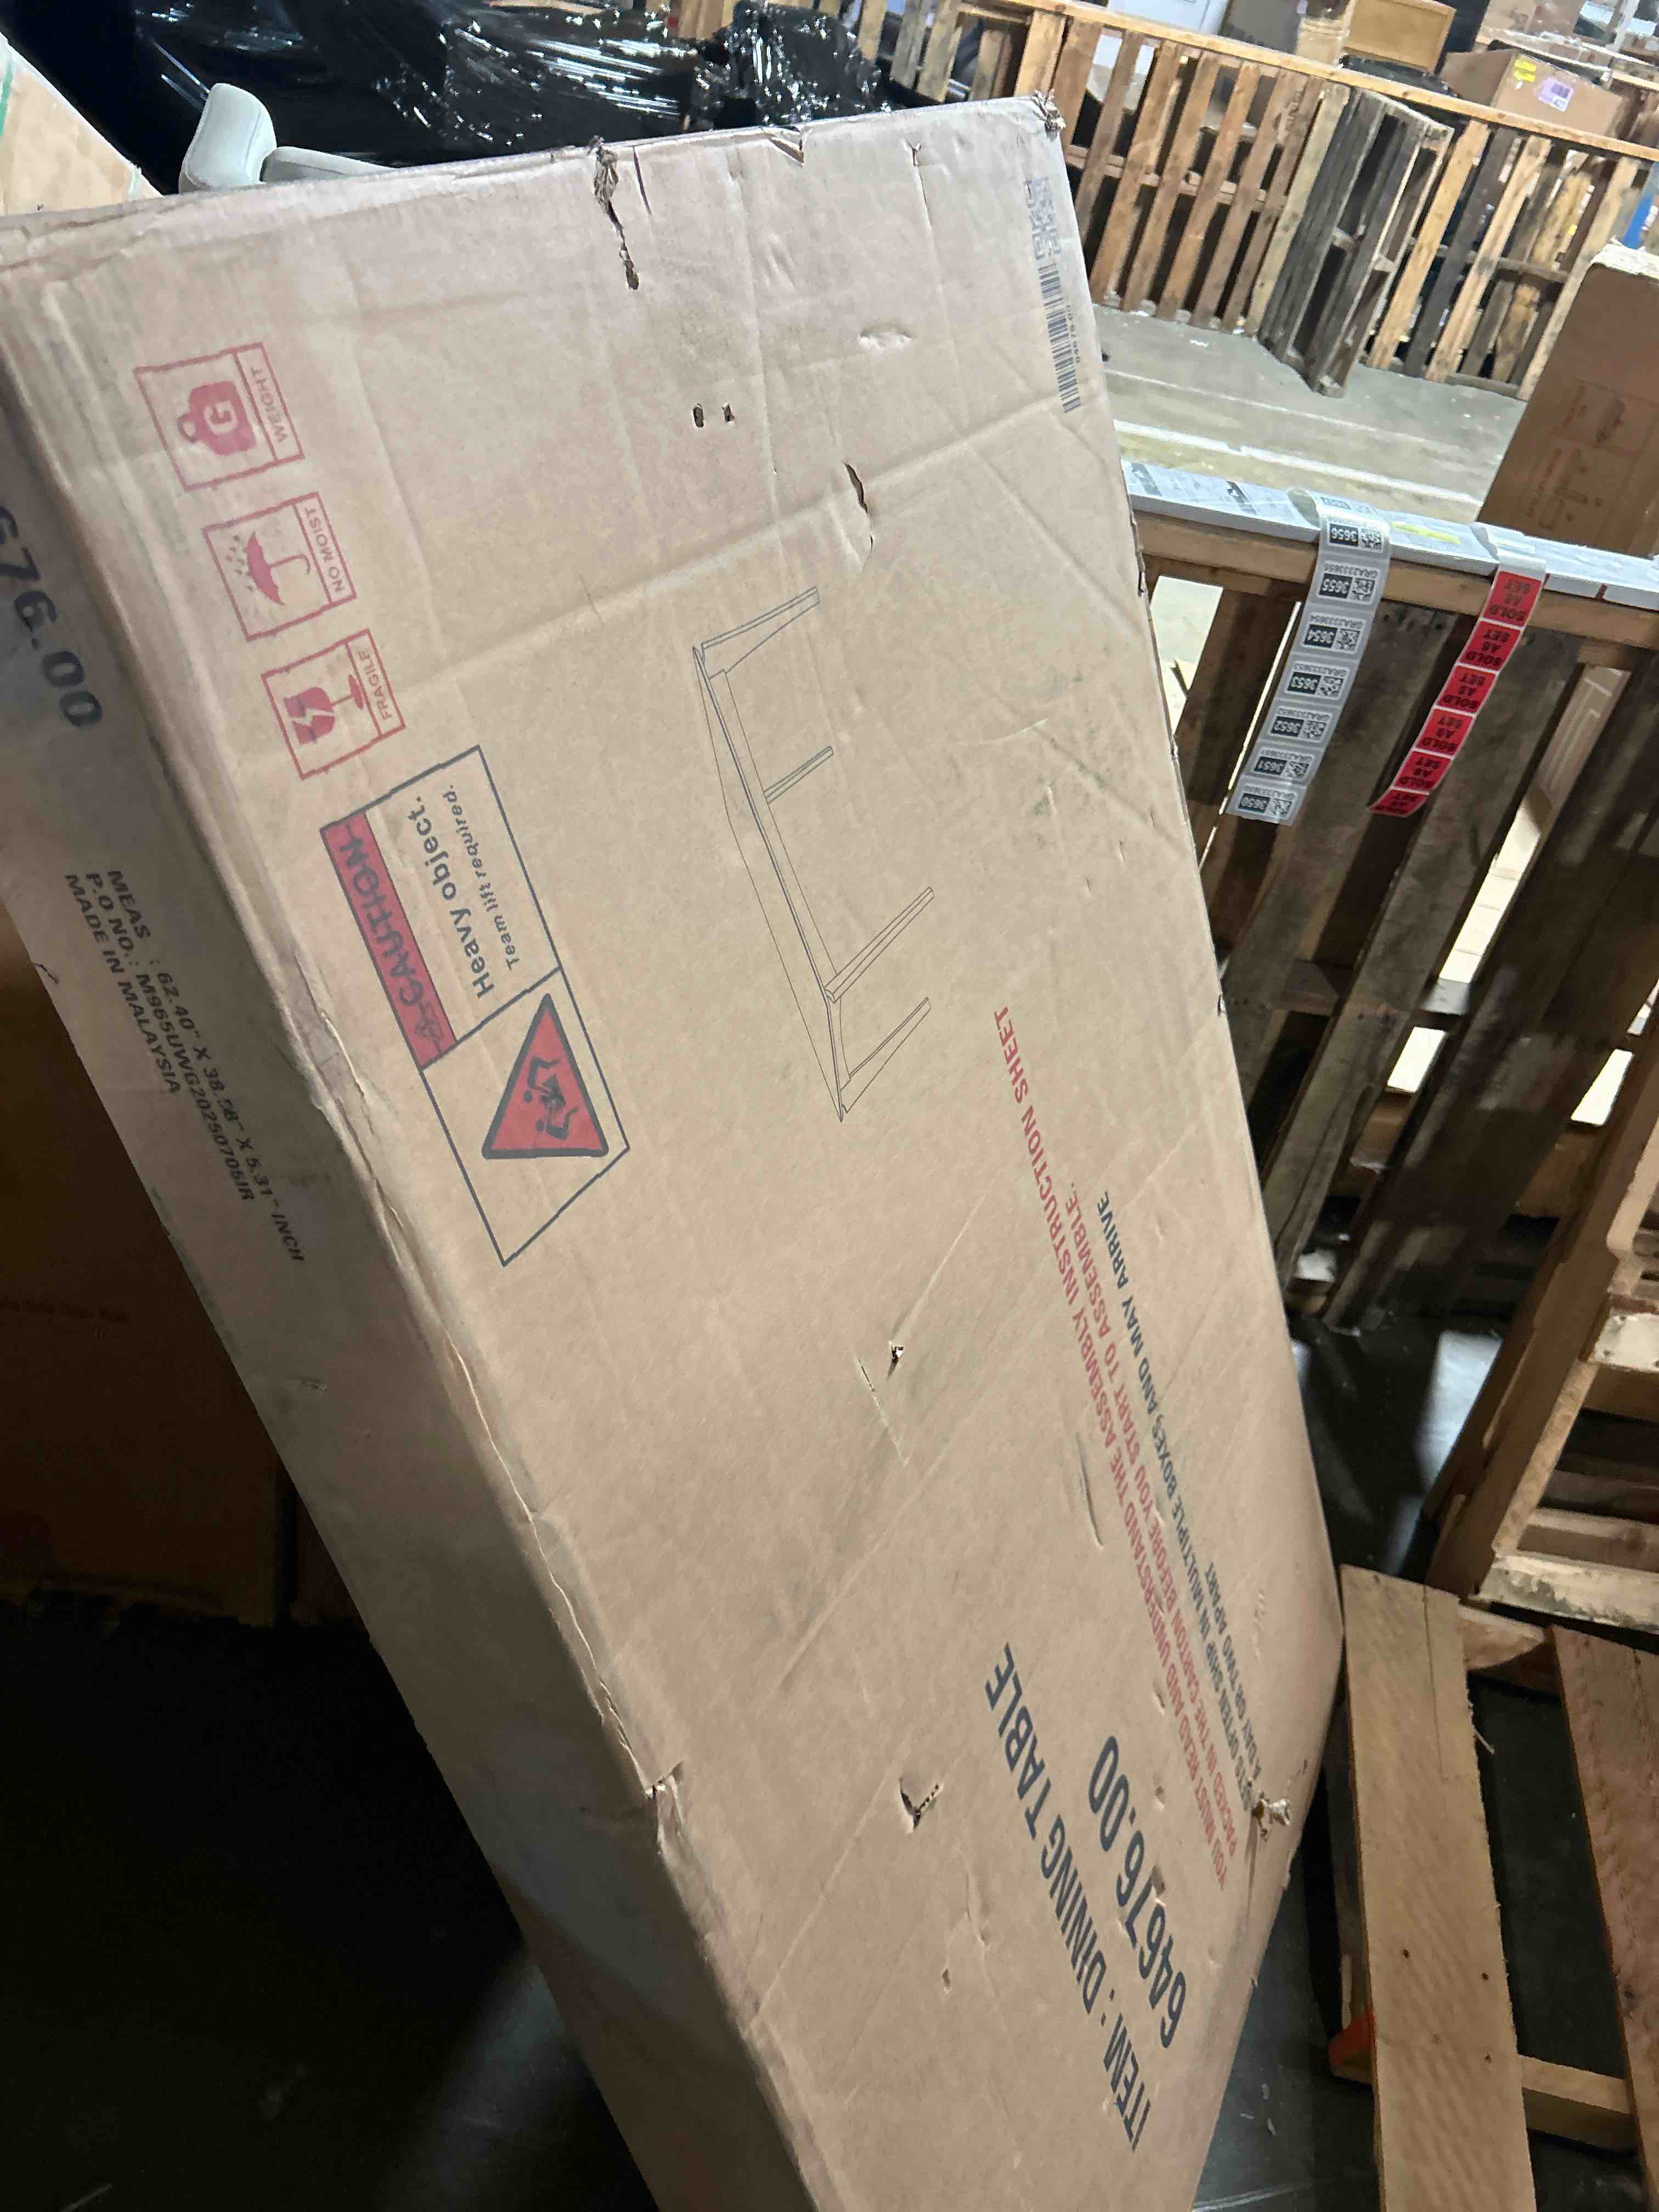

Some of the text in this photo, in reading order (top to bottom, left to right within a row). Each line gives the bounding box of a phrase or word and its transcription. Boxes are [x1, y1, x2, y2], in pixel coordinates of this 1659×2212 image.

[251, 367, 288, 443] WEIGHT
[304, 506, 345, 594] NO MOIST
[1331, 528, 1357, 542] 3656
[1322, 578, 1350, 594] 3655
[1490, 604, 1526, 621] SOLD
[1505, 580, 1531, 593] SET
[1307, 630, 1334, 644] 3654
[1466, 651, 1502, 668] SOLD
[1483, 630, 1510, 642] SET
[358, 650, 393, 720] FRAGILE
[1291, 676, 1318, 691] 3653
[1442, 695, 1477, 710] SOLD
[1460, 673, 1485, 686] SET
[1274, 720, 1301, 733] 3652
[1421, 737, 1456, 753] SOLD
[1437, 716, 1463, 729] SET
[1259, 760, 1284, 772] 3651
[1241, 797, 1267, 810] 3650
[408, 797, 494, 998] Heavy object.
[442, 785, 520, 970] Team lift required.
[340, 837, 425, 1006] CAUTION
[64, 873, 184, 1094] MADE IN MALAYSIA
[106, 869, 154, 939] MEAS
[190, 1045, 212, 1062] X
[233, 1136, 255, 1152] X
[268, 1210, 308, 1265] INCH
[1097, 1191, 1128, 1289] ARRIVE
[1121, 1295, 1144, 1358] MAY
[1139, 1357, 1158, 1415] AND
[994, 1007, 1227, 1890] YOU MUST READ AND UNDERSTAND THE ASSEMBLY INSTRUCTION SHEET
[1065, 1183, 1237, 1857] PACKED IN THE CARTON BEFORE YOU START TO ASSEMBLE.
[1172, 1495, 1204, 1612] MULTIPLE
[1199, 1607, 1210, 1641] IN
[1205, 1562, 1261, 1780] A DAY OR TWO APART
[1206, 1641, 1223, 1692] SHIP
[1218, 1688, 1239, 1759] OFTEN
[985, 1642, 1150, 2153] ITEM : DINING TABLE
[1089, 1736, 1186, 2047] 64676.00
